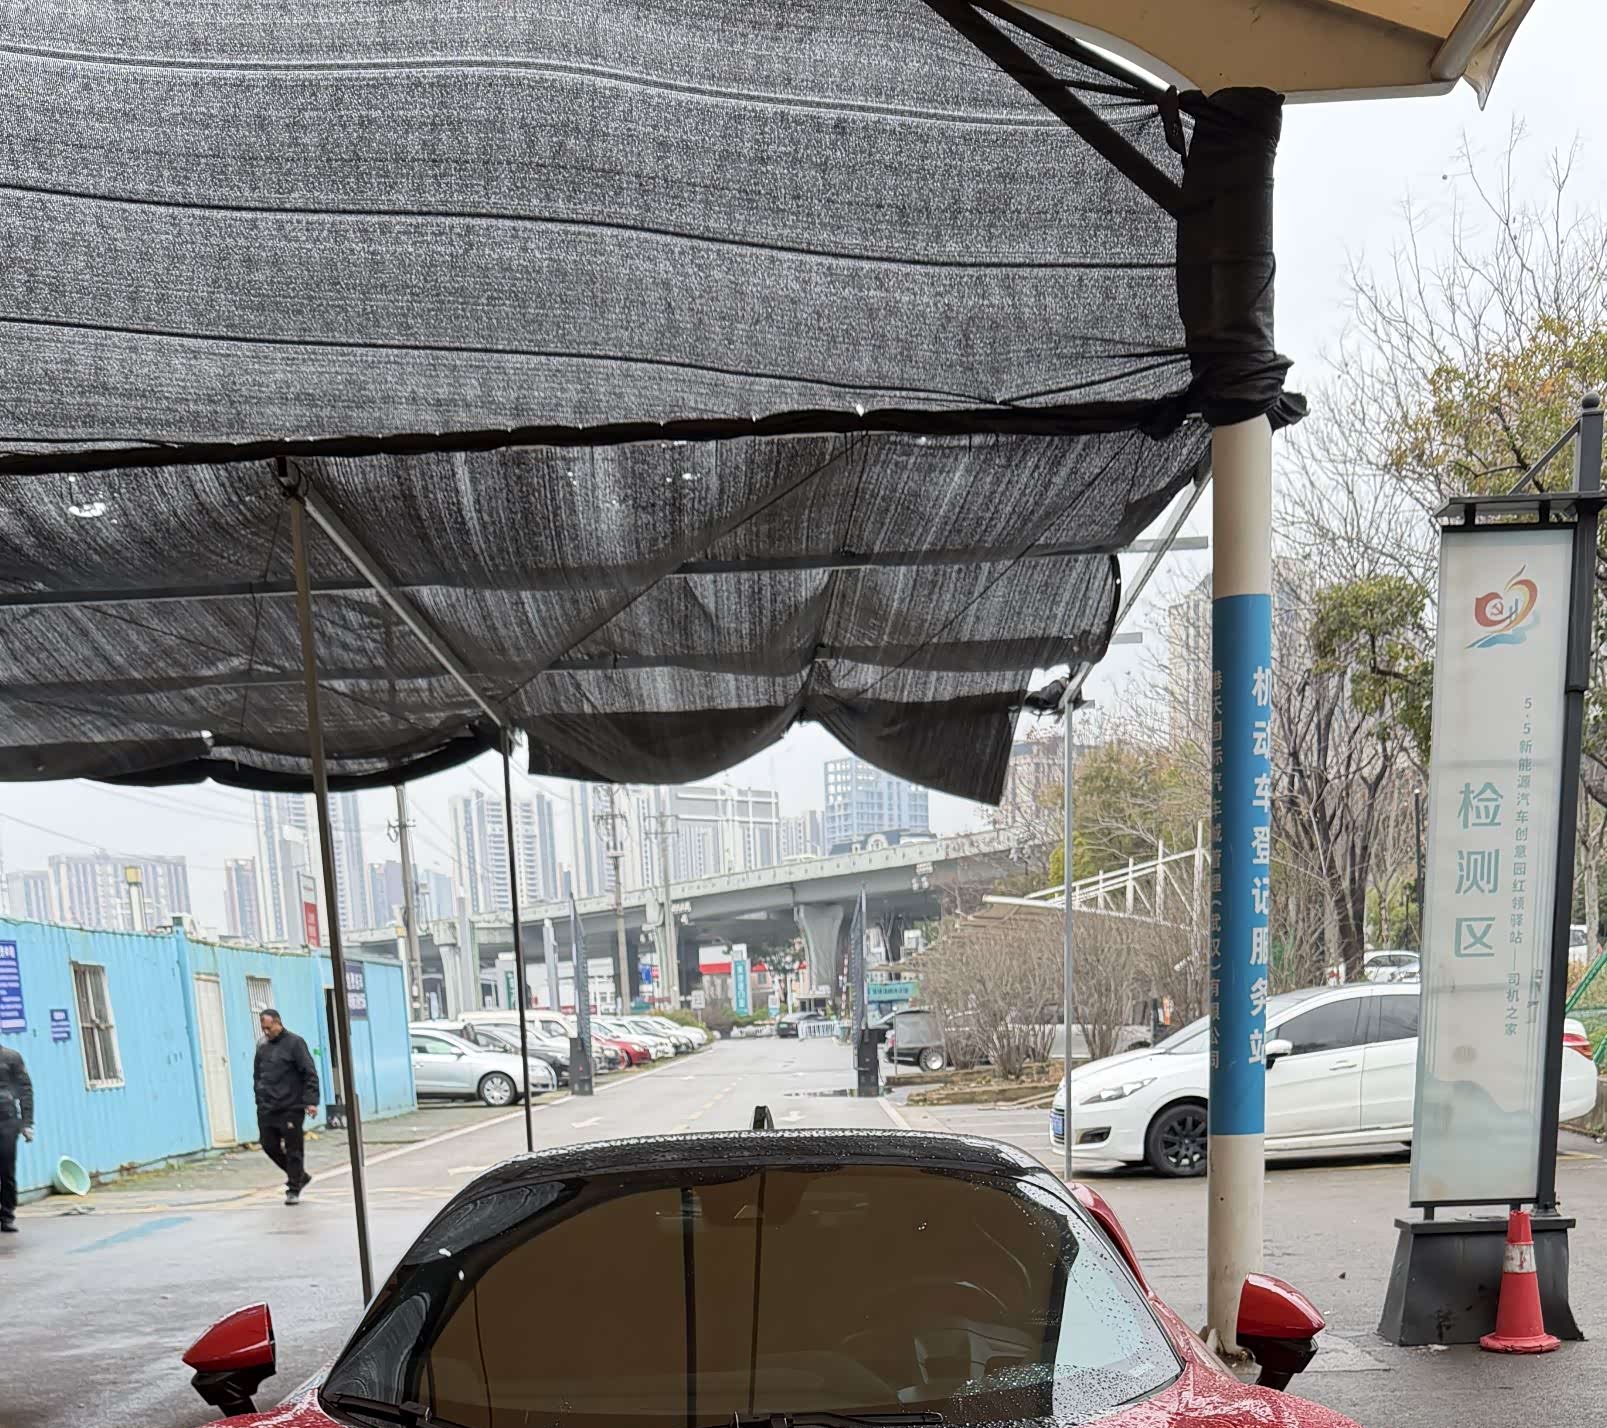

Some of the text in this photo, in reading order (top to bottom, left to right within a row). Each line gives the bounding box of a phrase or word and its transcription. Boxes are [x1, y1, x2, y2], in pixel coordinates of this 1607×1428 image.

[1248, 665, 1272, 1066] 机动车登记服务站
[1454, 781, 1503, 957] 检测区
